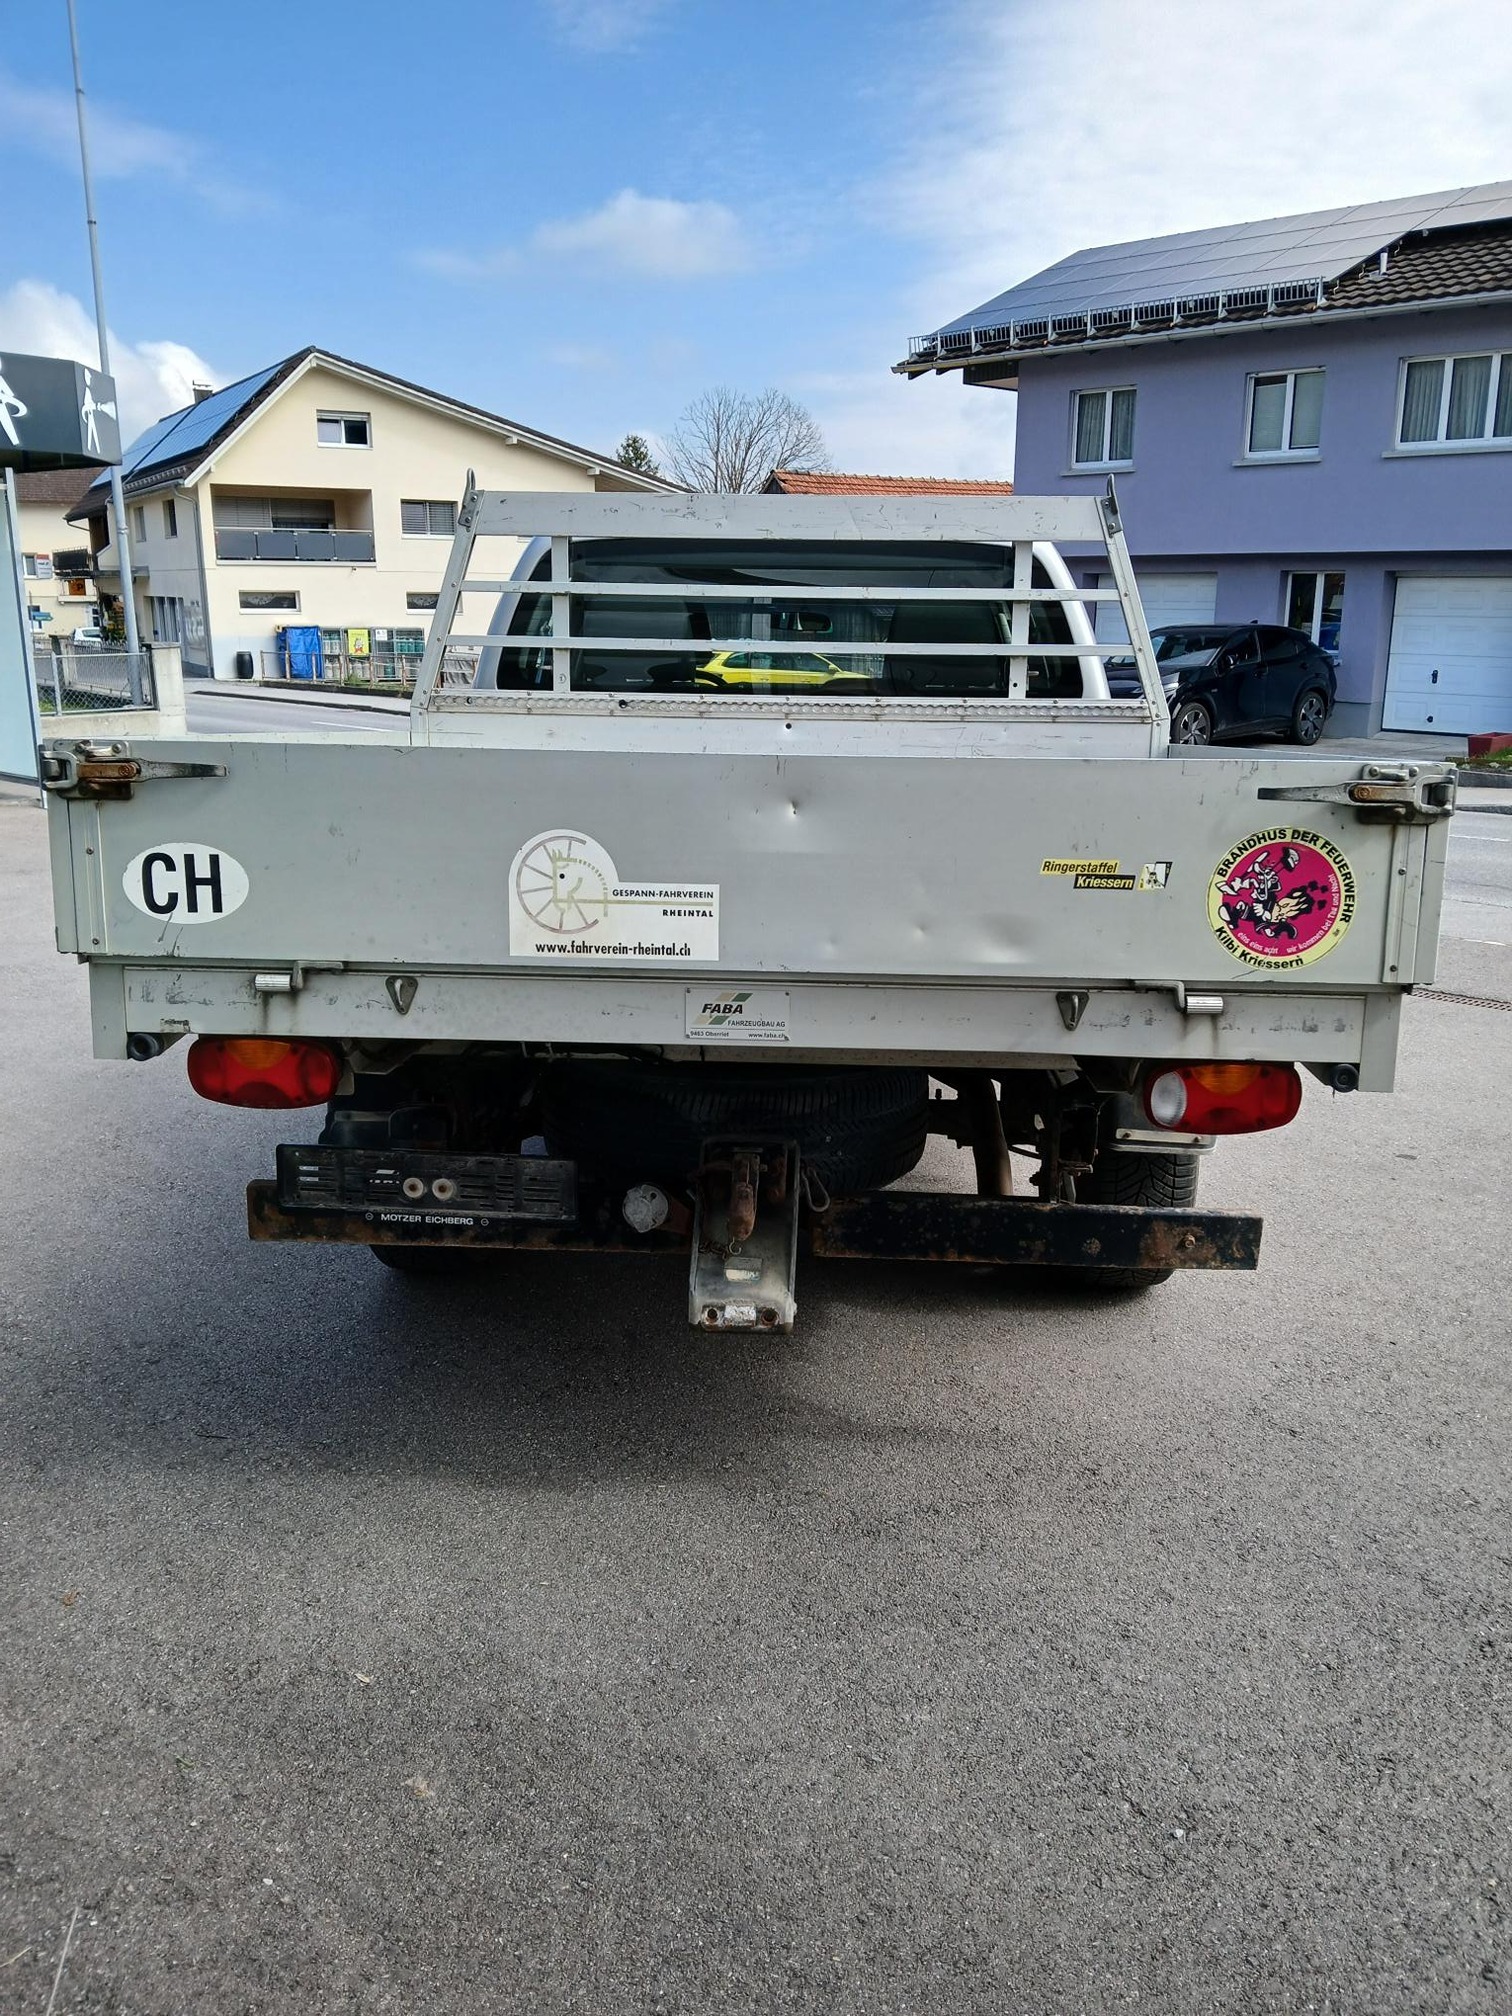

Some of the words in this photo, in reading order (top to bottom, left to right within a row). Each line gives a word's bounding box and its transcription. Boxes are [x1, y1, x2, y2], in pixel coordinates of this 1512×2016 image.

[1042, 861, 1118, 874] Ringerstaffel
[1077, 876, 1133, 888] Kriessern
[1217, 829, 1287, 877] BRANDHUS
[1291, 829, 1319, 846] DER
[1320, 841, 1355, 923] FEUERWEHR
[141, 852, 223, 915] CH
[612, 888, 714, 899] GESPANN-FAHRVEREIN
[662, 909, 714, 918] RHEINTAL
[535, 940, 691, 957] www.fahrverein-rheintal.ch
[1215, 926, 1240, 953] Kilbi
[1238, 950, 1304, 969] Kriessern
[701, 1003, 743, 1015] FABA
[776, 1020, 786, 1028] AG
[381, 1213, 422, 1223] MOTZER
[425, 1216, 474, 1226] EICHBERG
